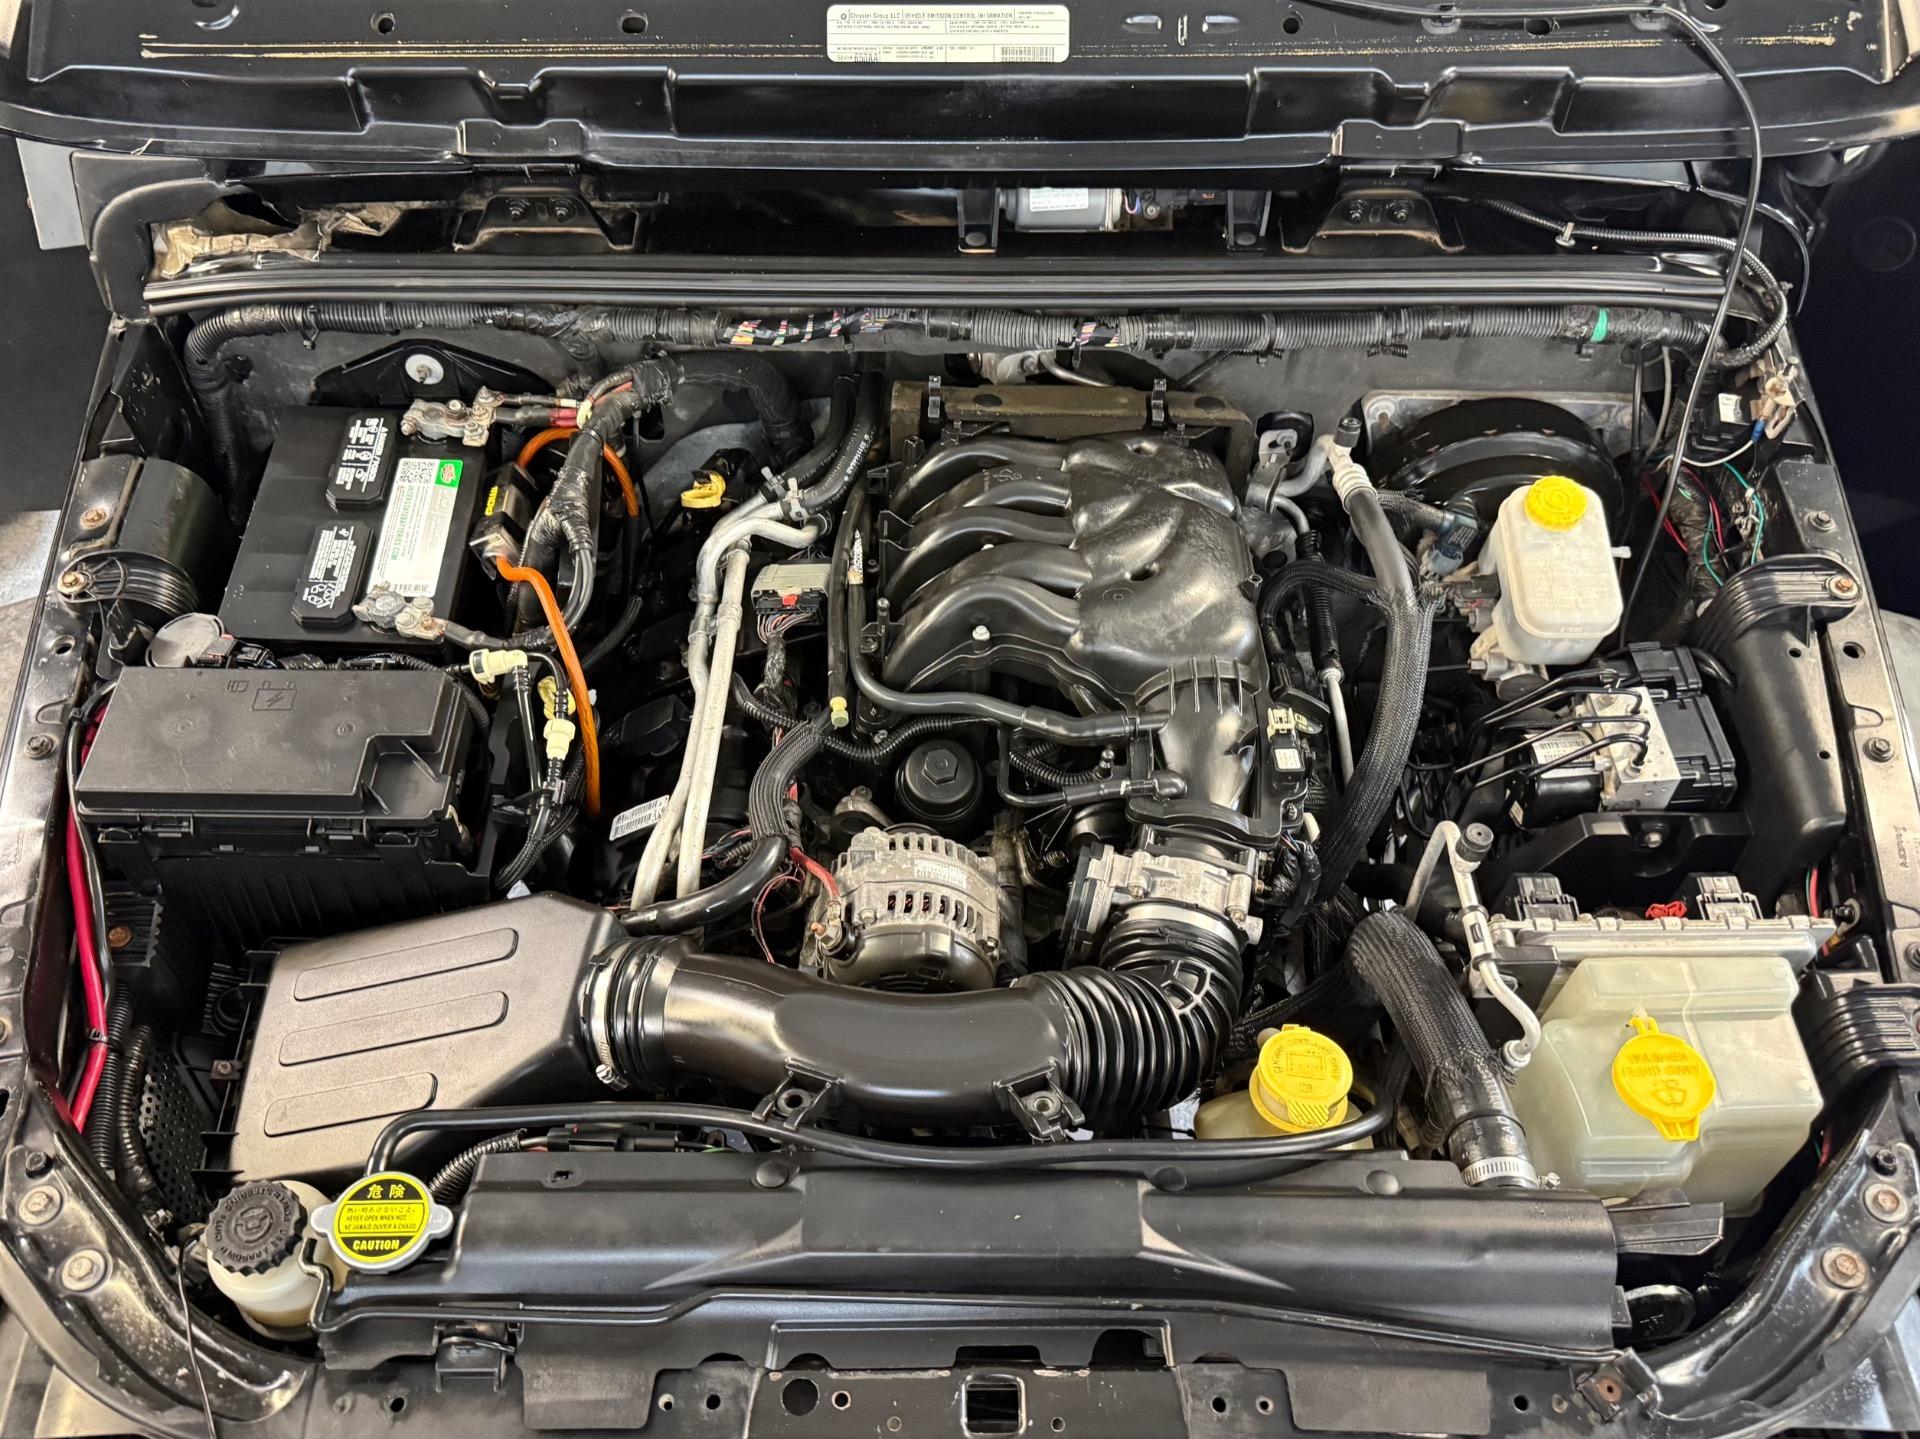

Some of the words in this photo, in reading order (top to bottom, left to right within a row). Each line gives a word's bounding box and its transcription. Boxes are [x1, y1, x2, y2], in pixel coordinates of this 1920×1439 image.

[850, 12, 872, 20] Chrysler
[873, 12, 889, 20] Group
[367, 1184, 406, 1199] 危険
[352, 1240, 400, 1251] CAUTION
